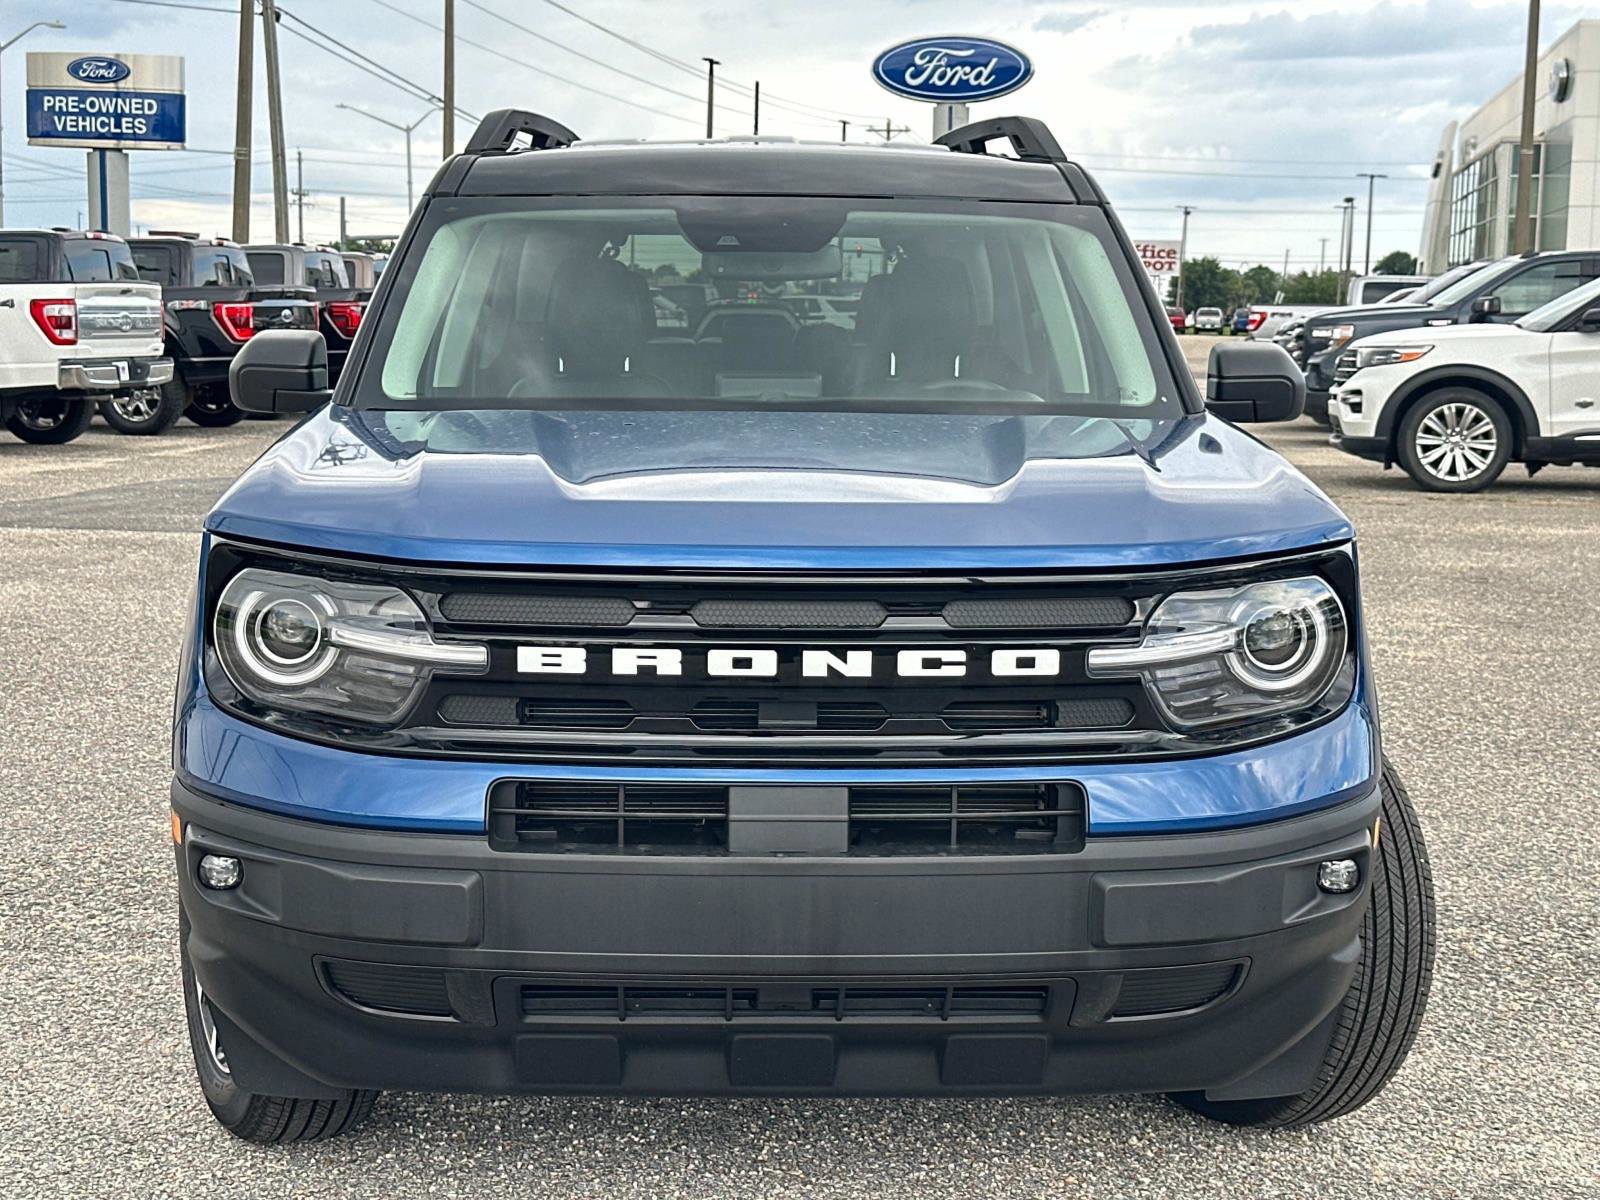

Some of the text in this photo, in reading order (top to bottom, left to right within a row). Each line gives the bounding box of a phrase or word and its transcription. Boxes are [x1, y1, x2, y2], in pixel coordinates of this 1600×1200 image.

[78, 61, 117, 78] Ford
[904, 47, 998, 87] Ford
[43, 96, 157, 114] PRE-OWNED
[54, 116, 147, 133] VEHICLES
[1135, 244, 1177, 259] ffice
[1143, 260, 1176, 271] POT
[517, 645, 1061, 678] BRONCO
